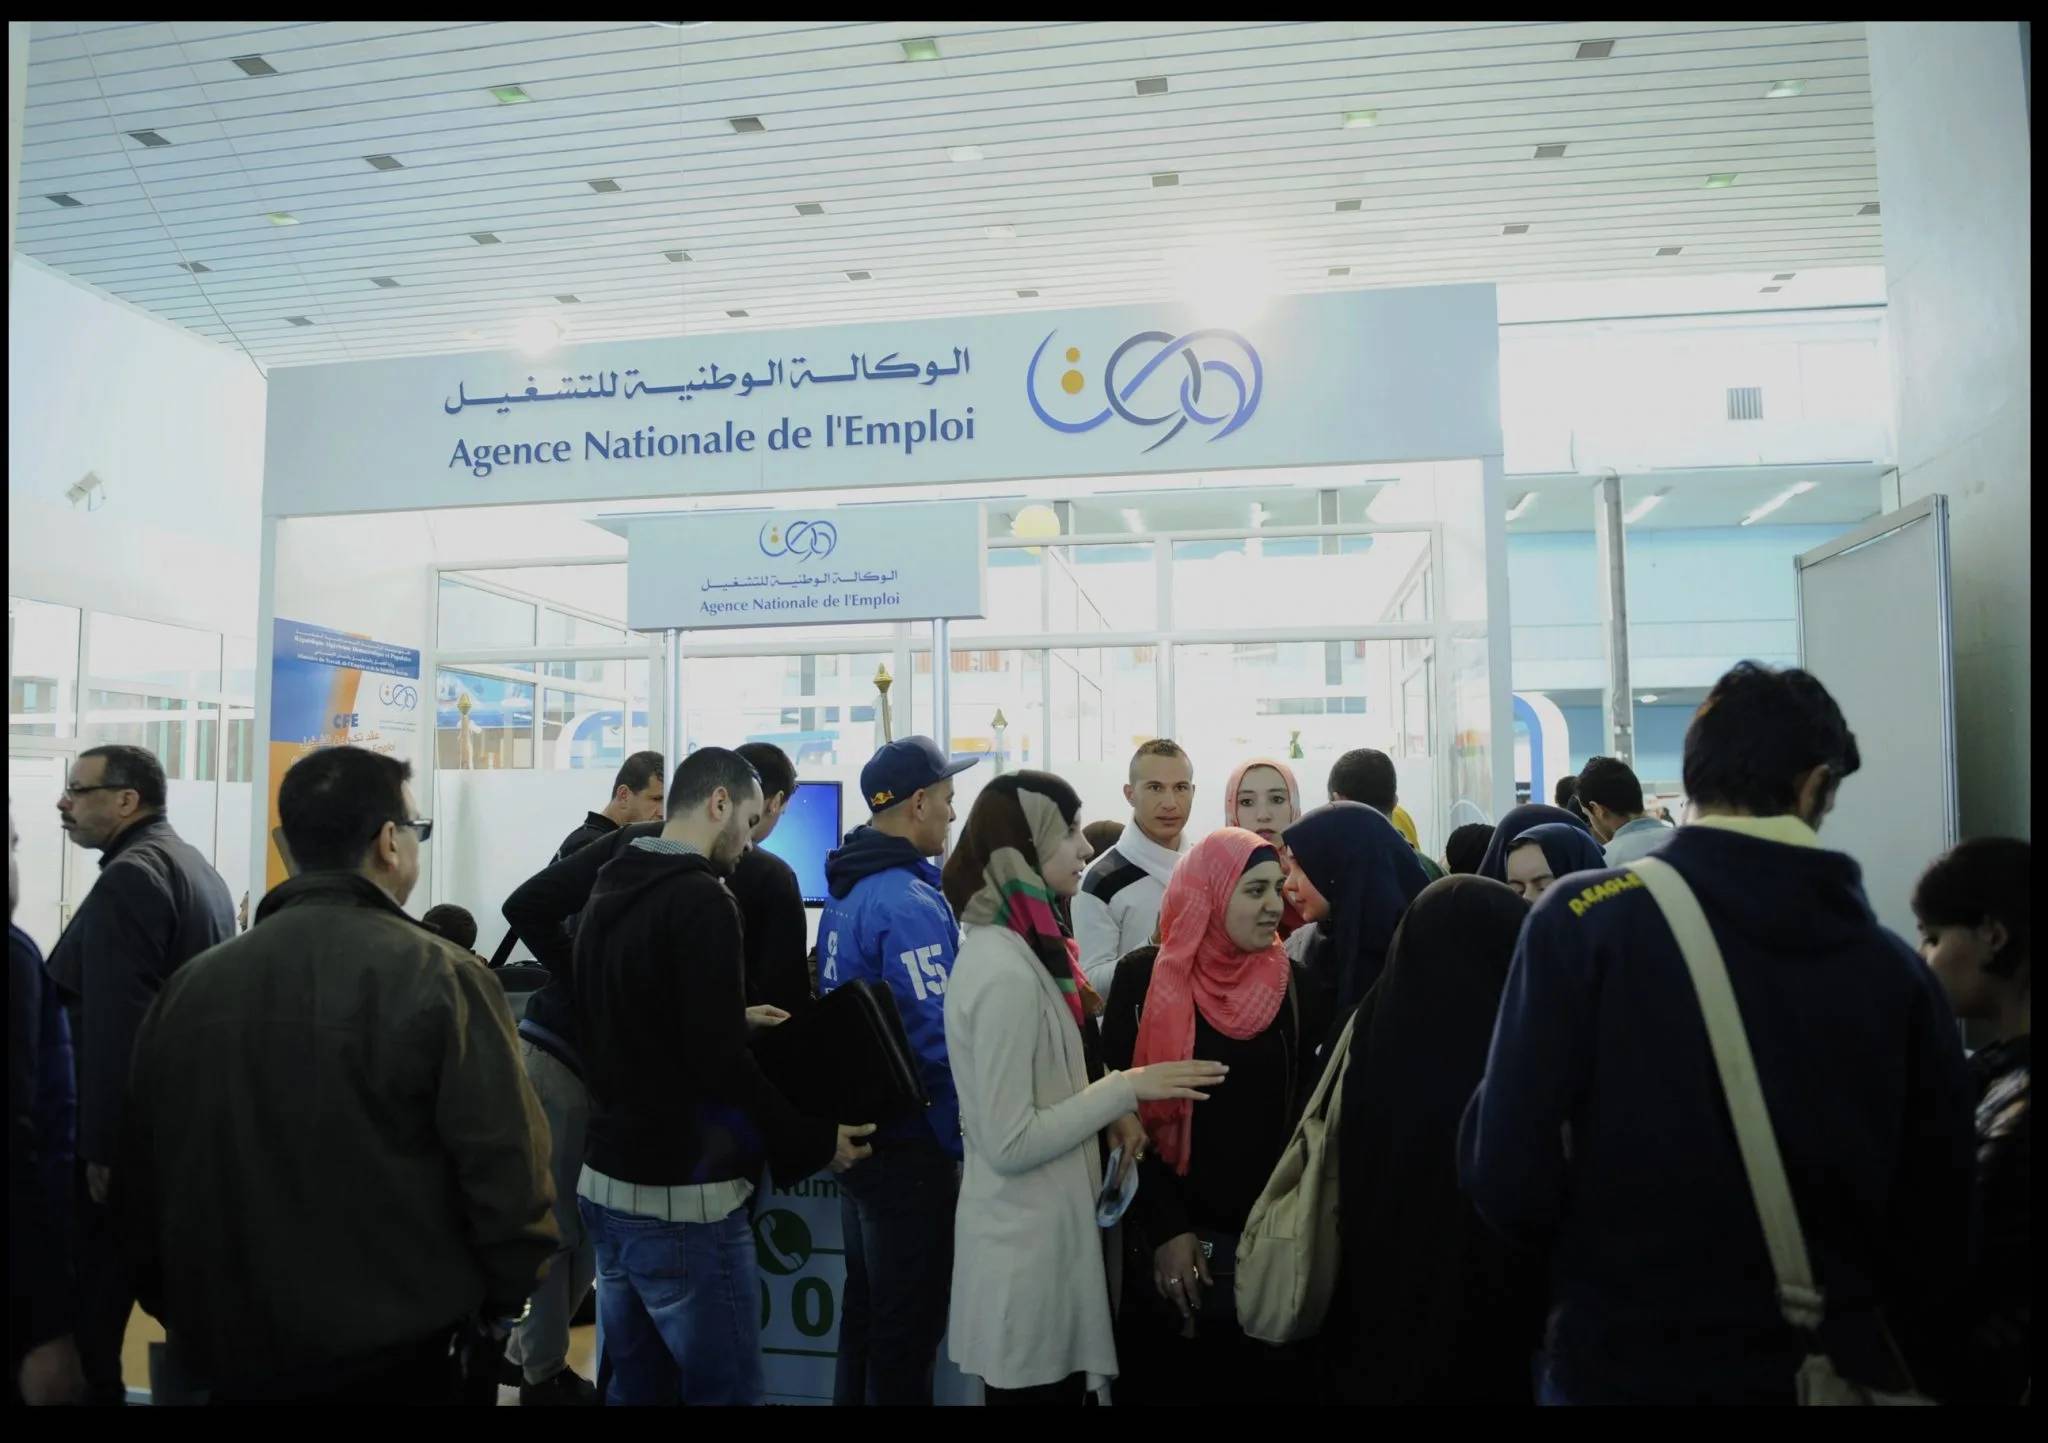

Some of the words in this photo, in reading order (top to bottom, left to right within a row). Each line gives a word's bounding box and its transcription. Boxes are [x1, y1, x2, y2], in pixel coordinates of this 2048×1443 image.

[624, 358, 783, 401] الوطنية
[790, 346, 970, 388] الوكالة
[444, 371, 617, 414] للتشغيل
[448, 437, 571, 477] Agence
[584, 420, 755, 462] Nationale
[767, 416, 812, 451] de
[825, 406, 974, 455] l'Emploi
[701, 576, 769, 591] للتشغيل
[832, 569, 898, 584] الوكالة
[699, 599, 749, 616] Agence
[752, 594, 819, 611] Nationale
[823, 593, 841, 608] de
[844, 592, 900, 609] l'Emploi
[332, 713, 359, 728] CFE
[899, 943, 948, 1000] 15
